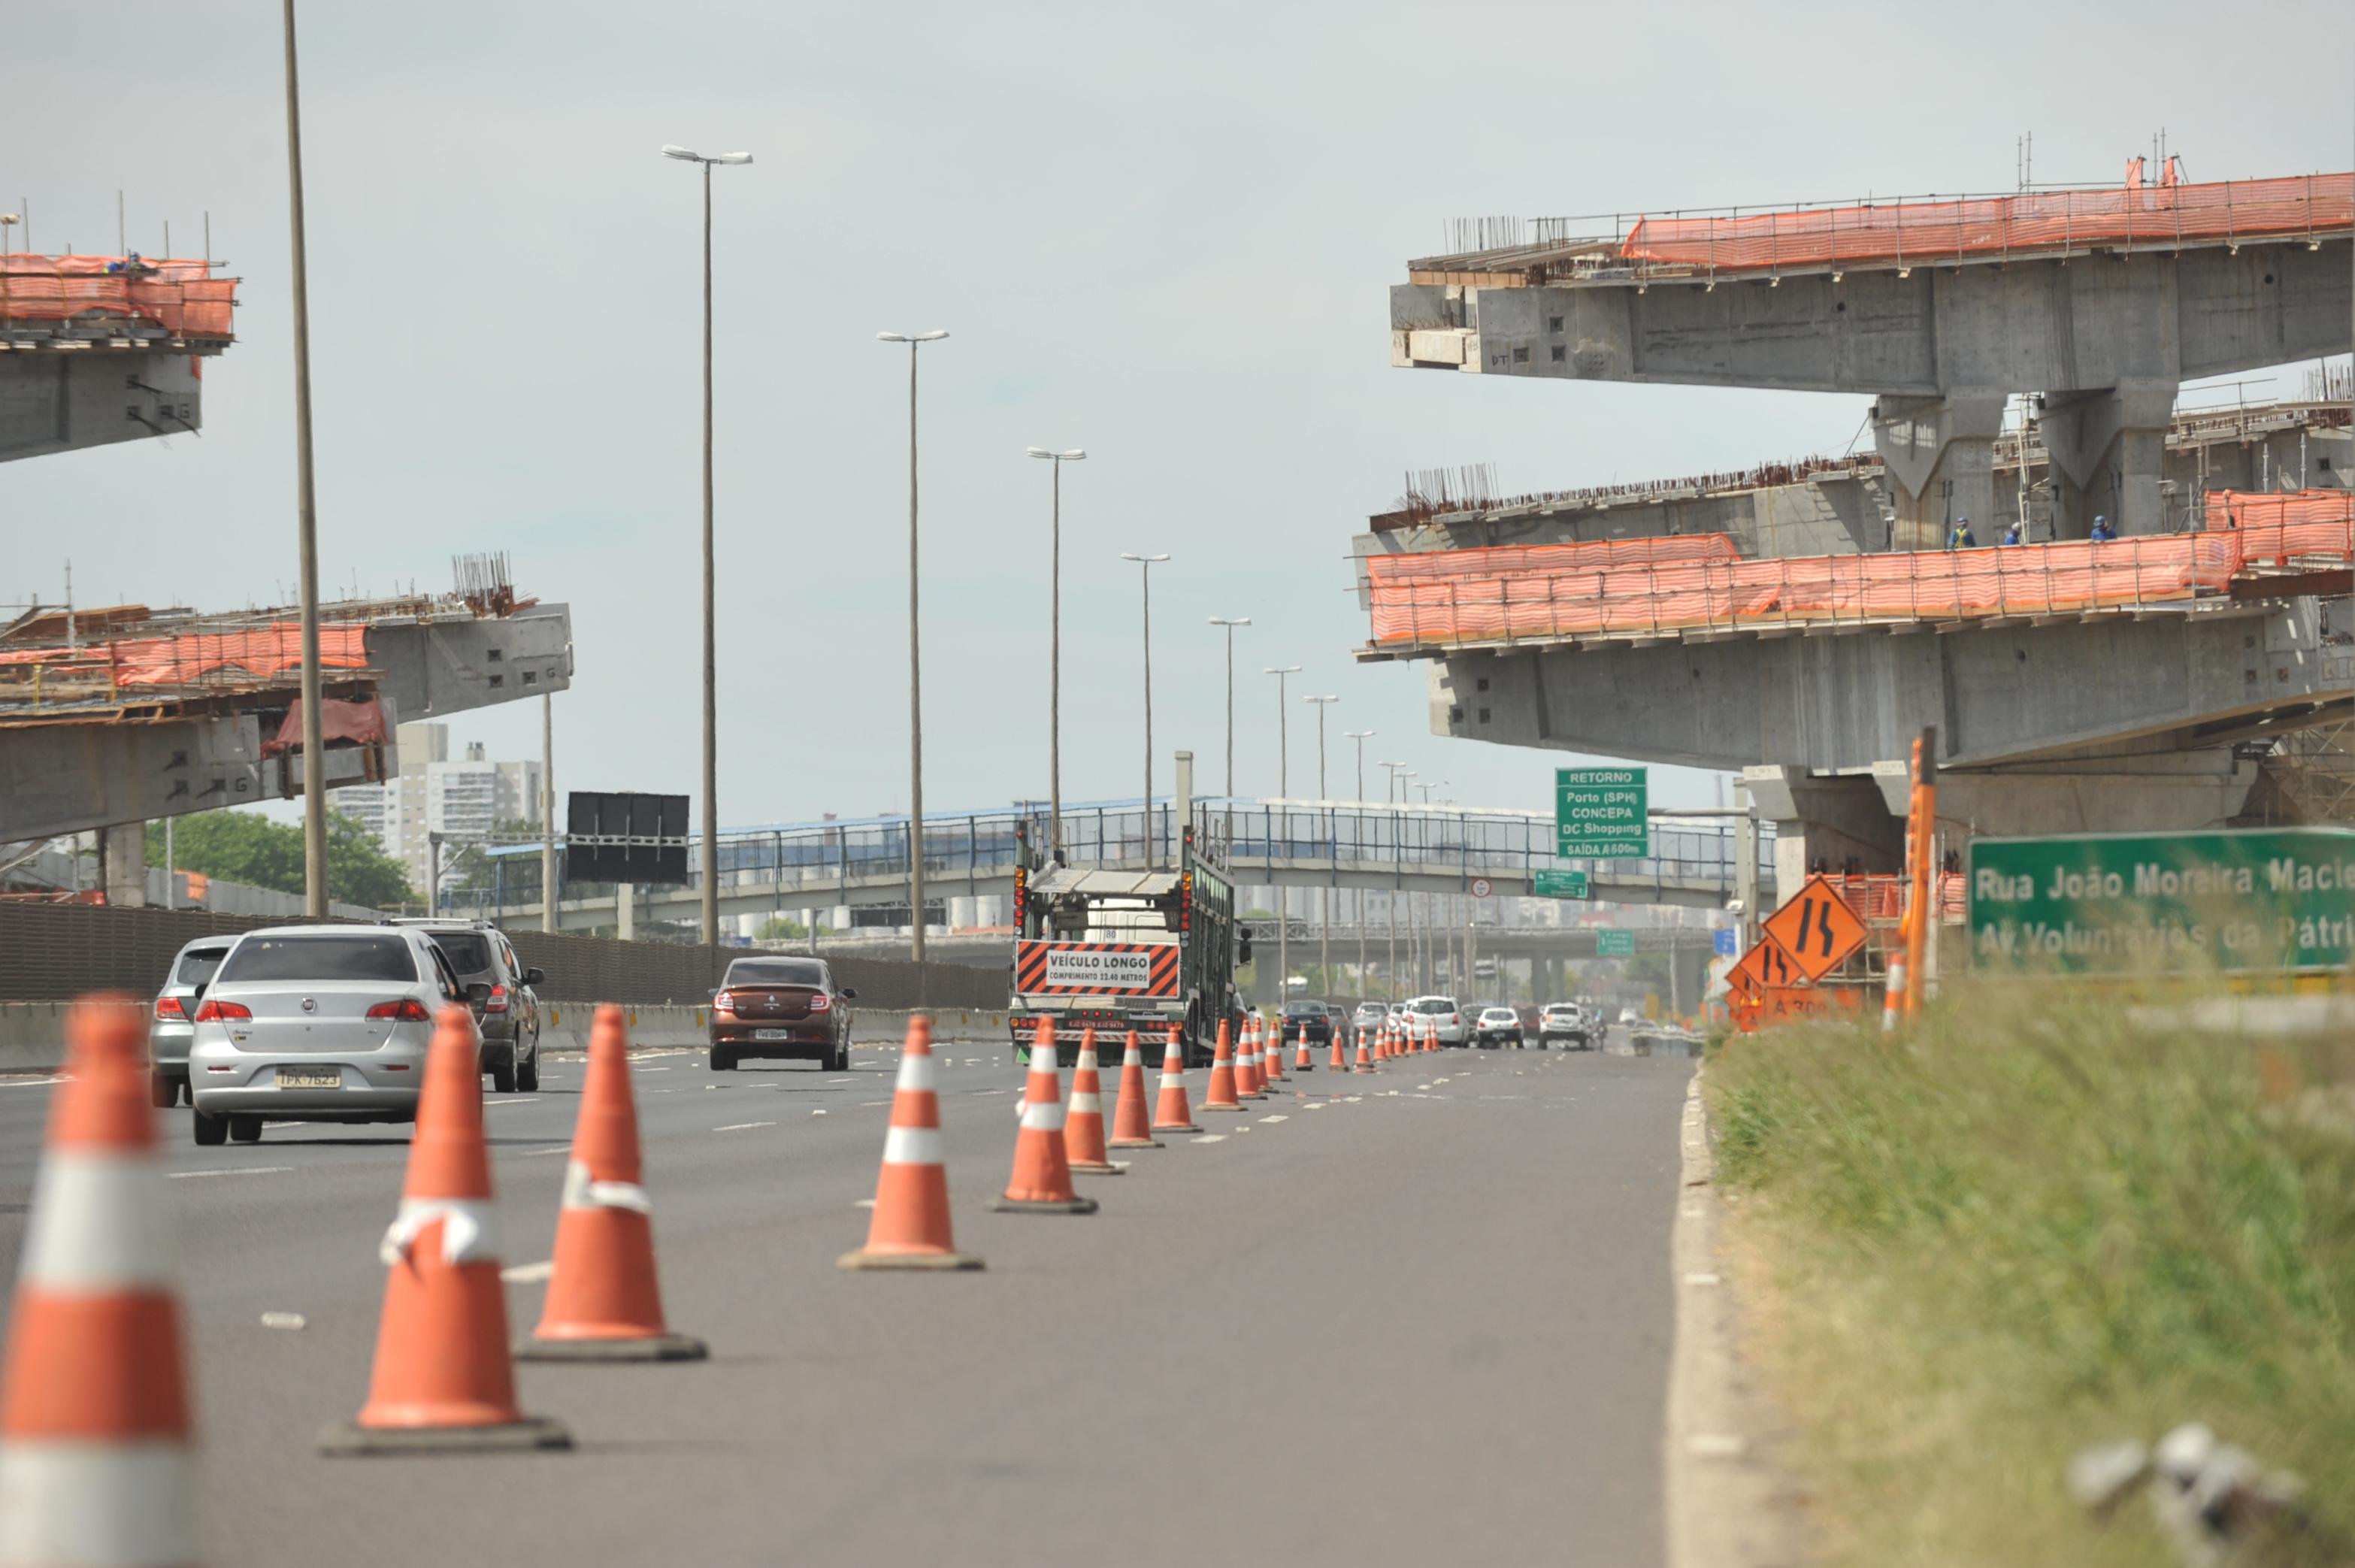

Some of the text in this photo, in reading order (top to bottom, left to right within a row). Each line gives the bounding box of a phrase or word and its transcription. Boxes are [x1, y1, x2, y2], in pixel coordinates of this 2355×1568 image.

[1570, 772, 1633, 783] RETORNO
[1566, 792, 1637, 805] Porto (SPH)
[1572, 807, 1633, 819] CONCEPA
[1563, 822, 1642, 836] DC Shopping
[1567, 843, 1600, 855] SAÍDA
[1602, 843, 1609, 855] A
[1976, 867, 2034, 901] Rua
[2047, 865, 2123, 899] João
[2134, 862, 2253, 896] Moreira
[2023, 919, 2208, 955] Volunários
[2223, 918, 2260, 949] da
[1050, 954, 1147, 968] VEÍCULO LONGO
[1049, 973, 1097, 981] COMPRIMENTO
